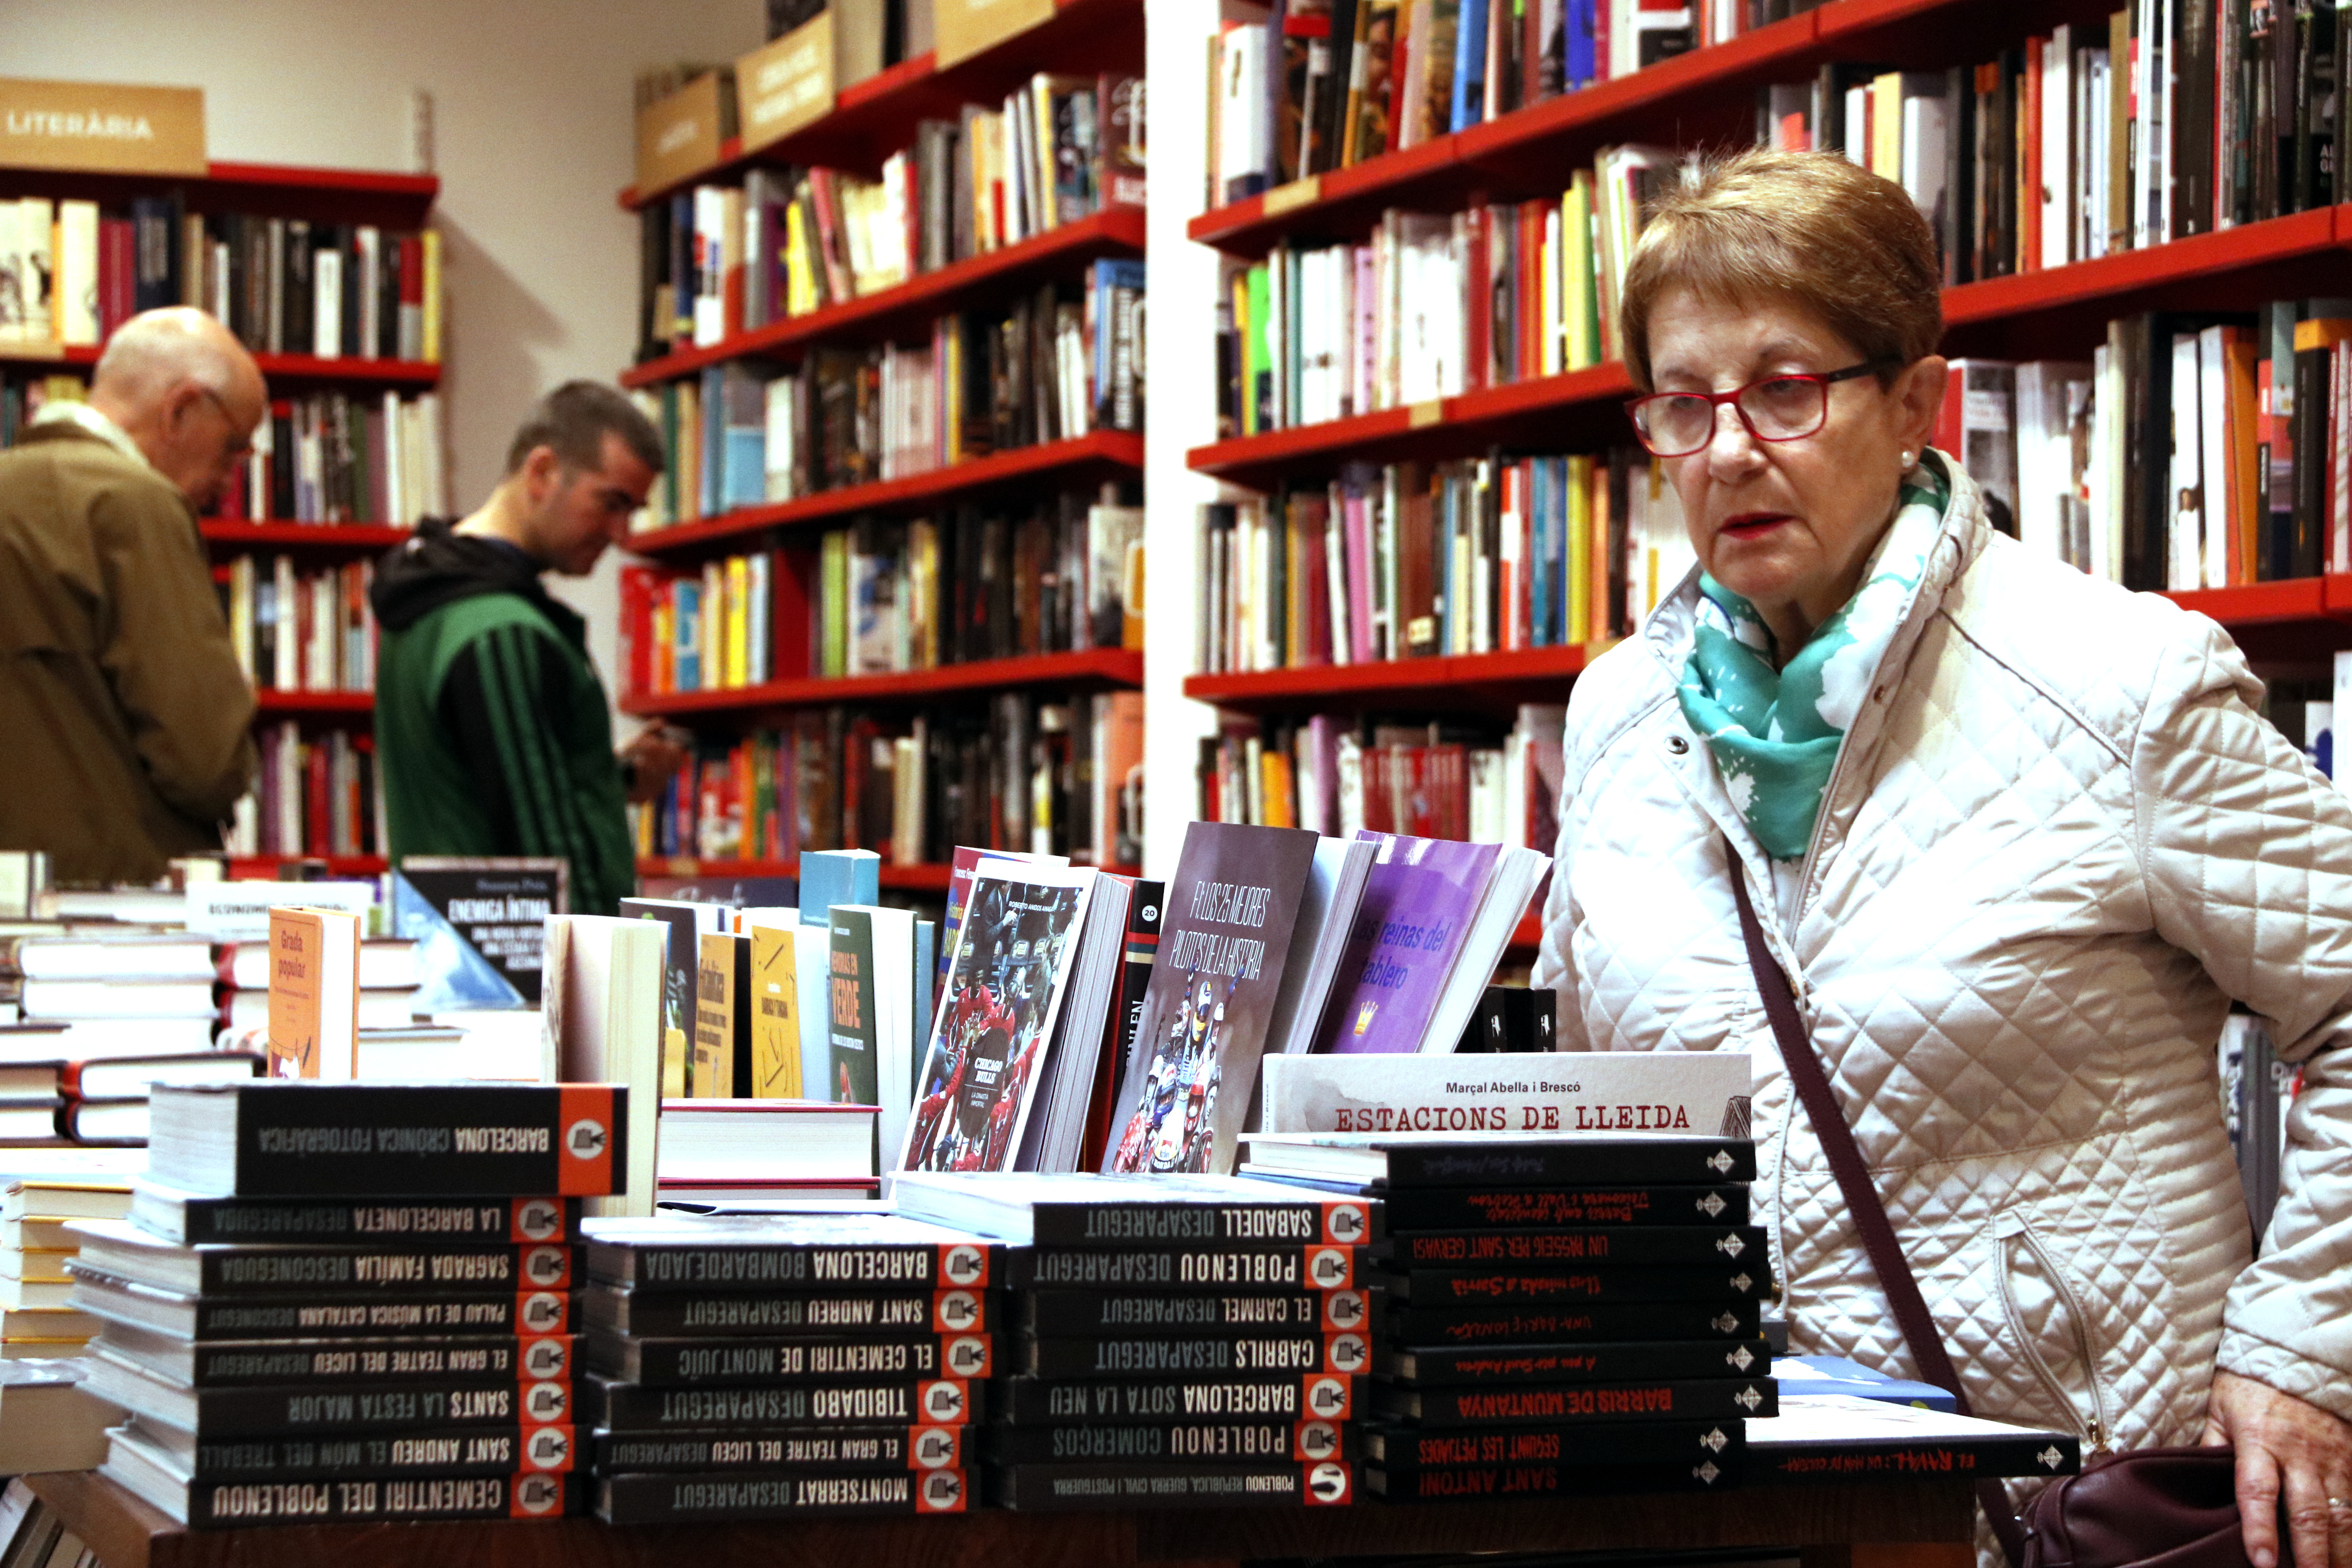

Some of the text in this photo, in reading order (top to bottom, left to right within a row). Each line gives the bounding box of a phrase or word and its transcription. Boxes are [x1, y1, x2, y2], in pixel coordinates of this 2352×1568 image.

[1009, 901, 1028, 910] ROBERTO
[1200, 882, 1222, 921] LOS
[1216, 884, 1234, 923] 25
[1228, 885, 1270, 927] MEJORES
[281, 930, 303, 952] Grada
[1378, 916, 1424, 949] reinas
[1423, 920, 1452, 951] del
[1169, 929, 1265, 980] PILOTOS DE LA HISTORIA
[279, 957, 306, 980] popular
[1361, 955, 1408, 989] tablero
[831, 977, 861, 1028] VERDE
[974, 1057, 1003, 1072] CHICAGO
[975, 1070, 996, 1084] BULLS
[1446, 1081, 1580, 1096] Marçal Abella i Brescó
[1335, 1104, 1690, 1133] ESTACIONS DE LLEIDA
[260, 1127, 549, 1158] BARCELONA CRÒNICA FOTOGRÀFICA
[353, 1207, 475, 1233] BARCELONETA
[481, 1207, 500, 1231] LA
[1085, 1209, 1312, 1238] SABADELL DESAPAREGUT
[1412, 1235, 1608, 1260] UN PASSEIG PER SANT GERVASI
[220, 1254, 509, 1287] SAGRADA FAMÍLIA DESCONEGUDA
[645, 1250, 927, 1280] BARCELONA BOMBARDEJADA
[1033, 1253, 1297, 1282] POBLENOU DESAPAREGUT
[298, 1305, 367, 1327] CATALANA
[370, 1305, 422, 1329] MÚSICA
[425, 1305, 442, 1325] LA
[444, 1304, 462, 1325] DE
[465, 1303, 506, 1324] PALAU
[683, 1299, 923, 1325] SANT ANDREU DESAPAREGUT
[1099, 1297, 1311, 1324] EL CARMEL DESAPAREGUT
[314, 1353, 356, 1375] LICEU
[359, 1351, 387, 1373] DEL
[390, 1350, 444, 1373] TEATRE
[449, 1349, 486, 1370] GRAN
[493, 1349, 508, 1369] EL
[678, 1343, 933, 1381] EL CEMENTIRI DE MONTJUÏC
[1095, 1339, 1314, 1370] CABRILS DESAPAREGUT
[288, 1390, 509, 1423] SANTS LA FESTA MAJOR
[661, 1388, 908, 1422] TIBIDABO DESAPAREGUT
[1049, 1384, 1295, 1415] BARCELONA SOTA LA NEU
[1456, 1387, 1673, 1418] BARRIS DE MUNTANYA
[391, 1438, 460, 1464] ANDREU
[465, 1438, 510, 1462] SANT
[712, 1441, 752, 1463] LICEU
[756, 1440, 782, 1462] DEL
[786, 1439, 837, 1461] TEATRE
[842, 1439, 878, 1460] GRAN
[882, 1438, 899, 1458] EL
[1170, 1426, 1286, 1455] POBLENOU
[1418, 1433, 1560, 1465] SEGUINT LES PETJADES
[1956, 1452, 1975, 1469] EL
[1053, 1477, 1115, 1495] POSTGUERRA
[1118, 1477, 1121, 1494] I
[1124, 1477, 1148, 1494] CIVIL
[1151, 1476, 1188, 1493] GUERRA
[1245, 1474, 1295, 1491] POBLENOU
[1418, 1465, 1558, 1496] SANT ANTONI
[212, 1478, 502, 1517] CEMENTIRI DEL POBLENOU
[672, 1477, 908, 1510] MONTSERRAT DESAPAREGUT
